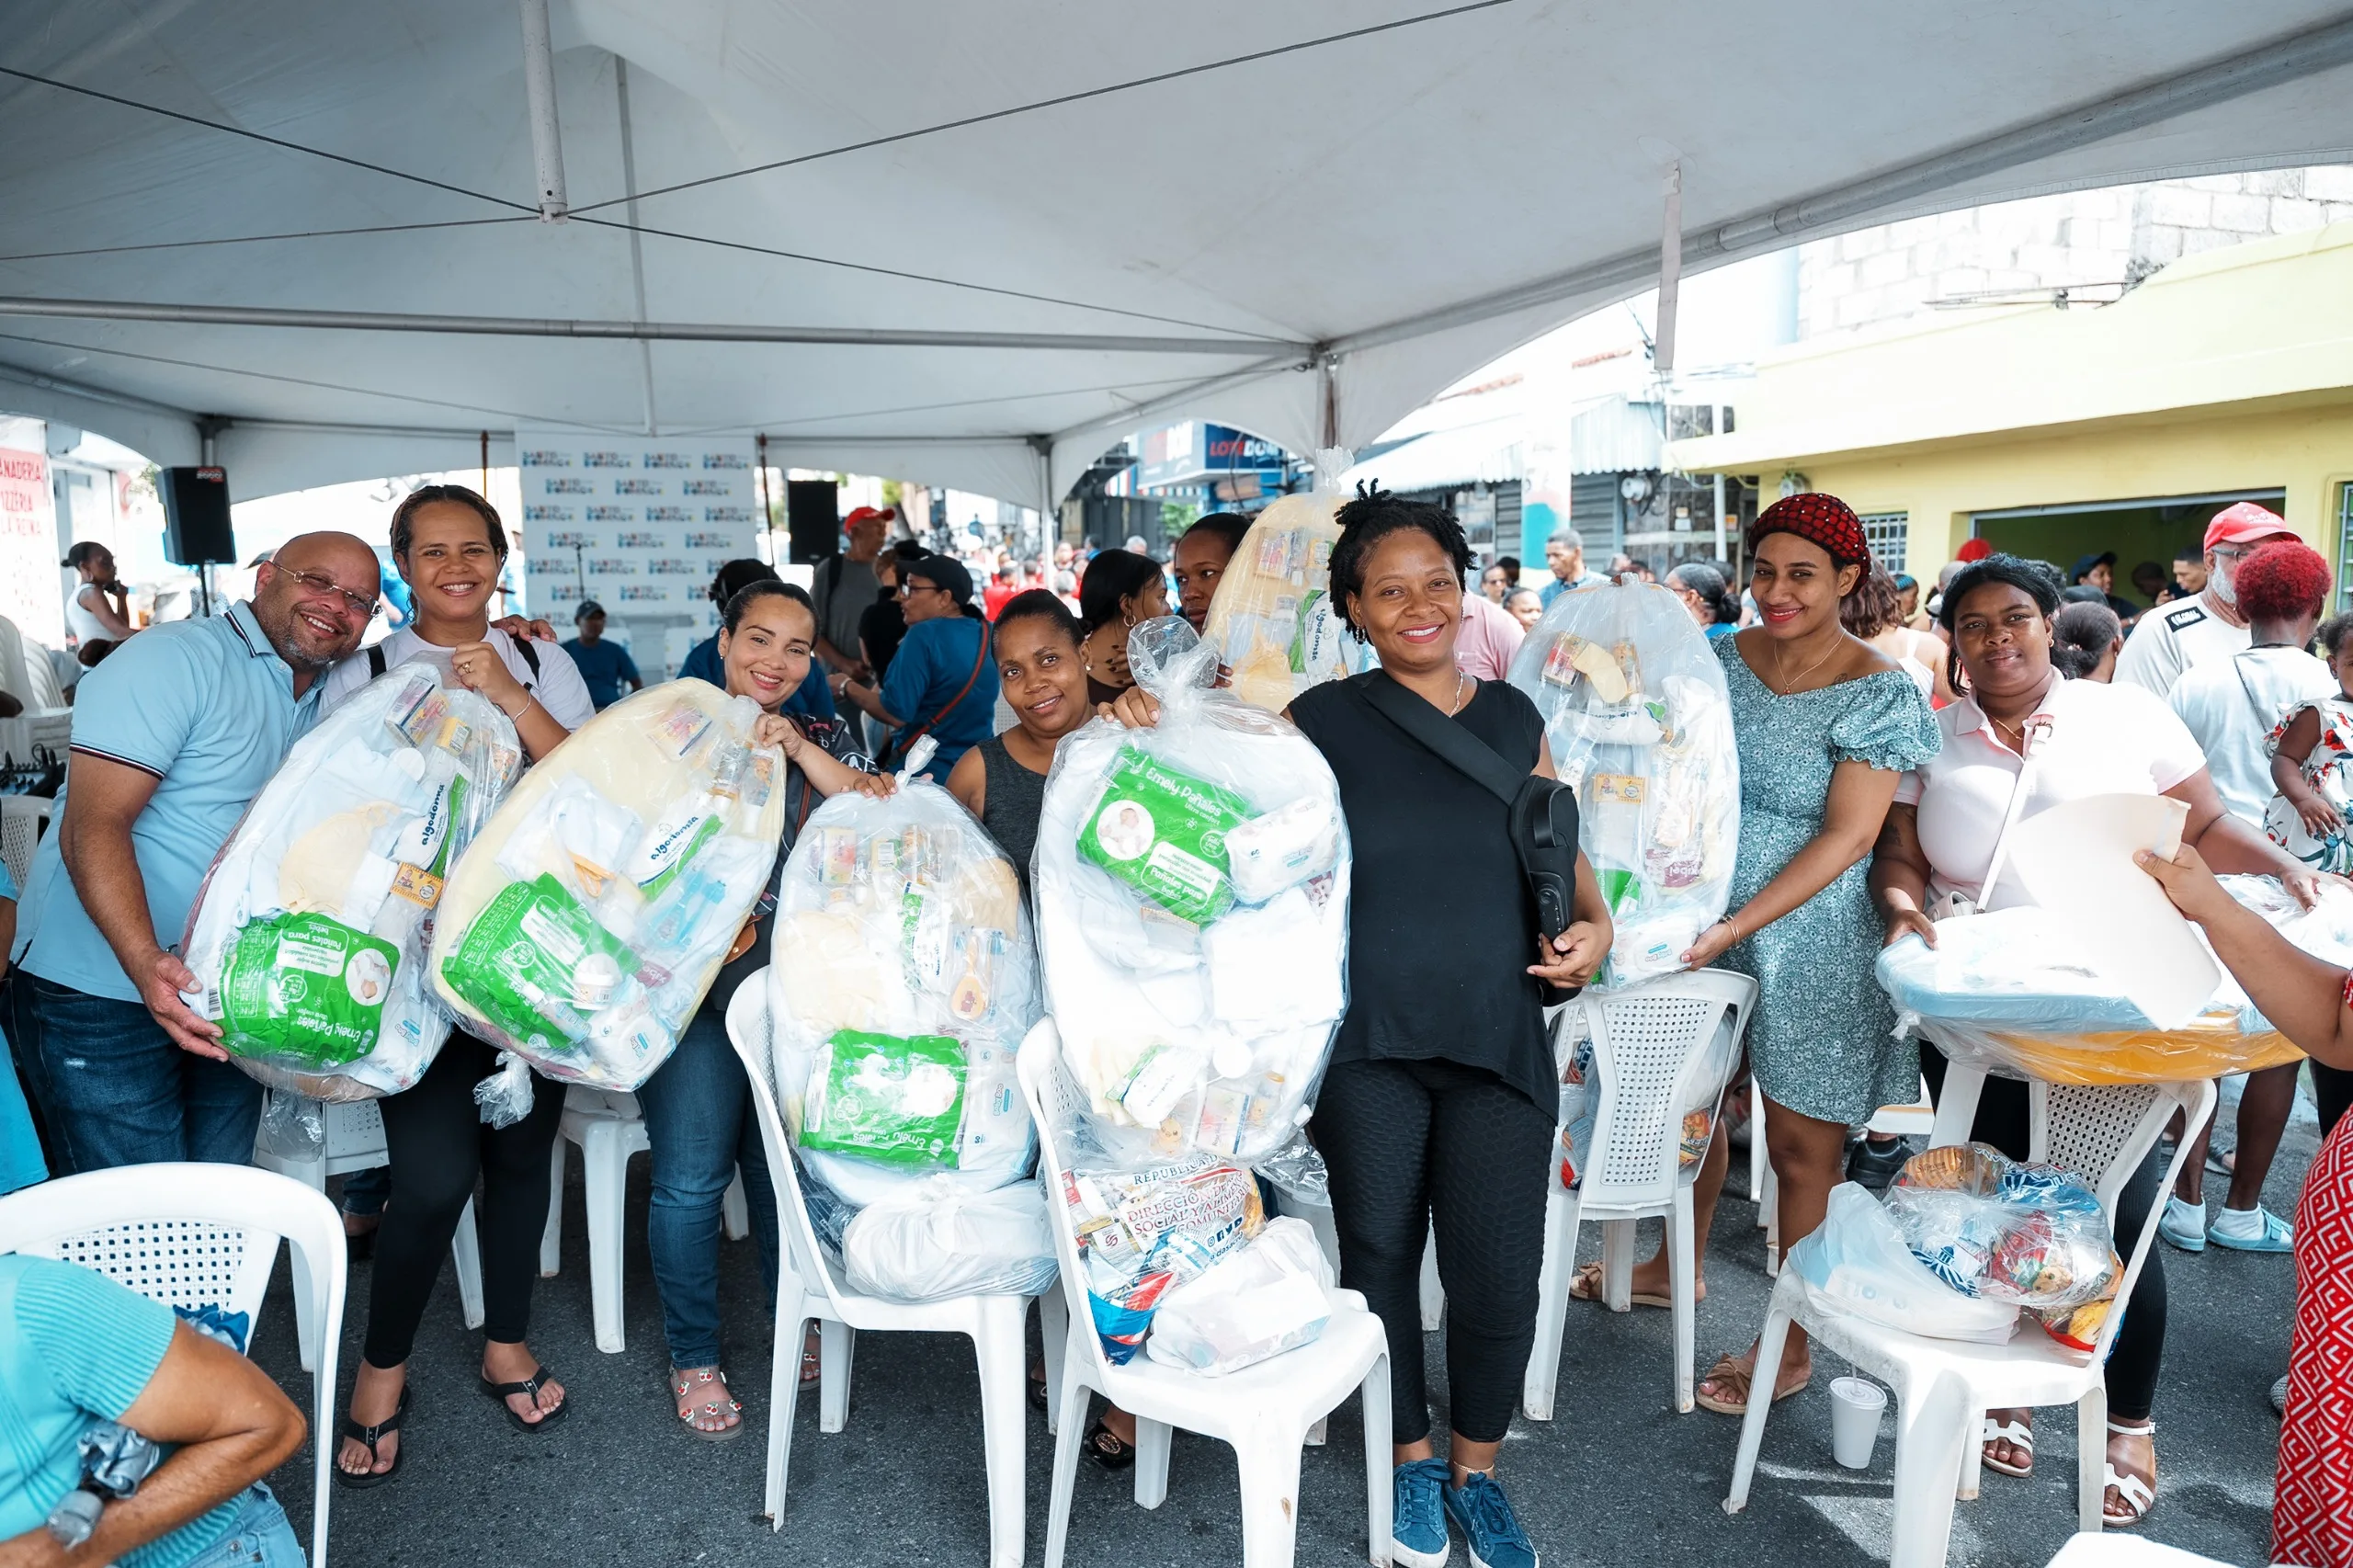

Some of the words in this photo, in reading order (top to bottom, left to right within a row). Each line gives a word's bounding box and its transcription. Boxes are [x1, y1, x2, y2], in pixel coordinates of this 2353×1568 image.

[1145, 767, 1179, 796] Emely
[1181, 787, 1222, 816] Pañales
[288, 931, 310, 941] para
[309, 924, 329, 936] bebés
[312, 936, 342, 950] Pañales
[335, 1022, 361, 1042] Emely
[1134, 1210, 1188, 1235] SOCIAL
